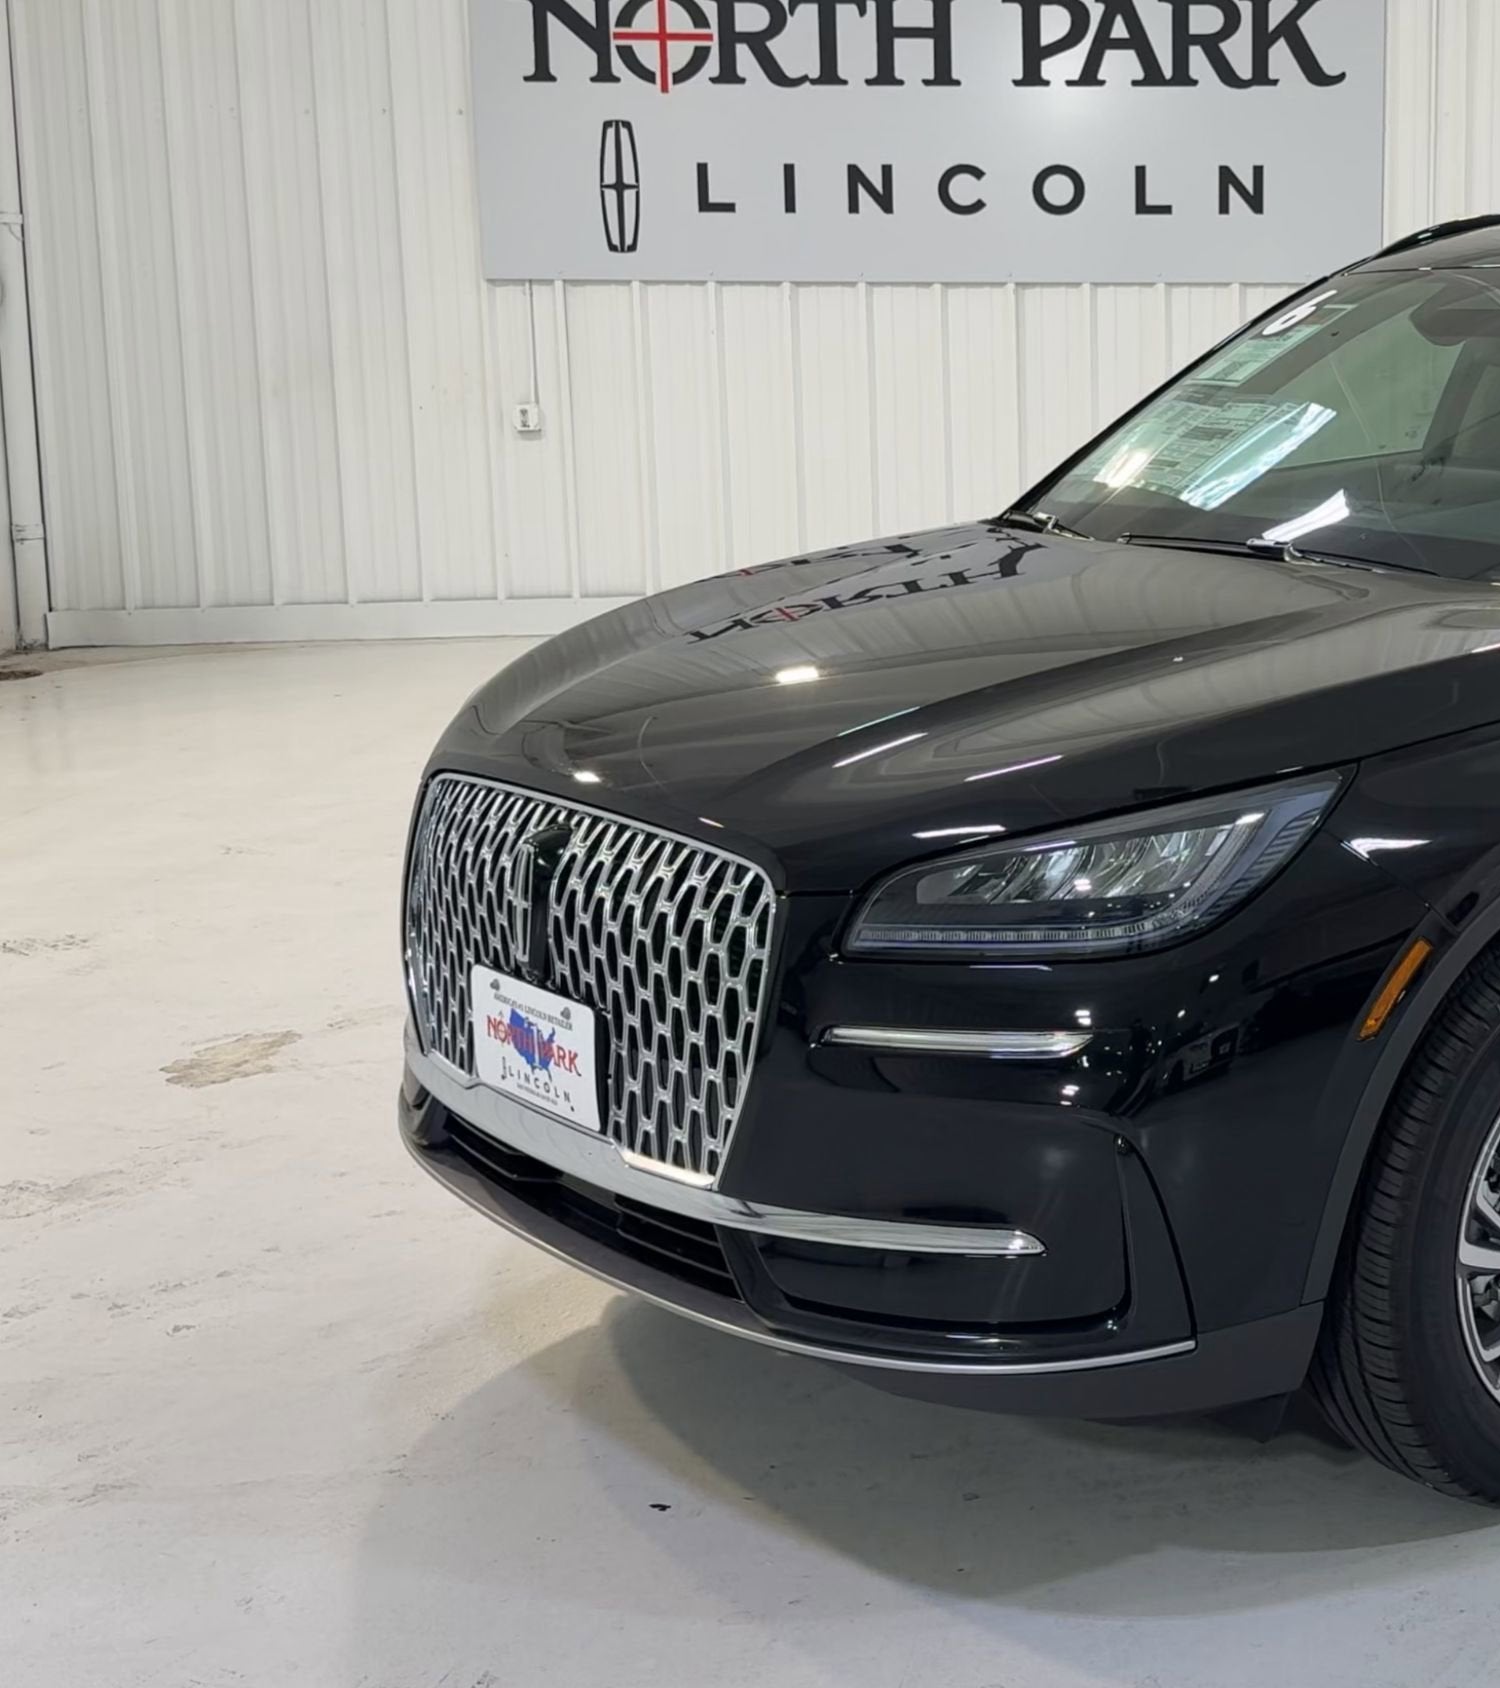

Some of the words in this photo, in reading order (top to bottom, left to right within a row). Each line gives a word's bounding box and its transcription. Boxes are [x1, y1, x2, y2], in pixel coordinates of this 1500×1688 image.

[522, 0, 962, 91] NORTH
[1011, 0, 1346, 89] PARK
[697, 162, 1264, 216] LINCOLN
[487, 1014, 535, 1054] NORTH
[539, 1029, 582, 1077] PARK
[508, 1065, 571, 1103] LINCOLN
